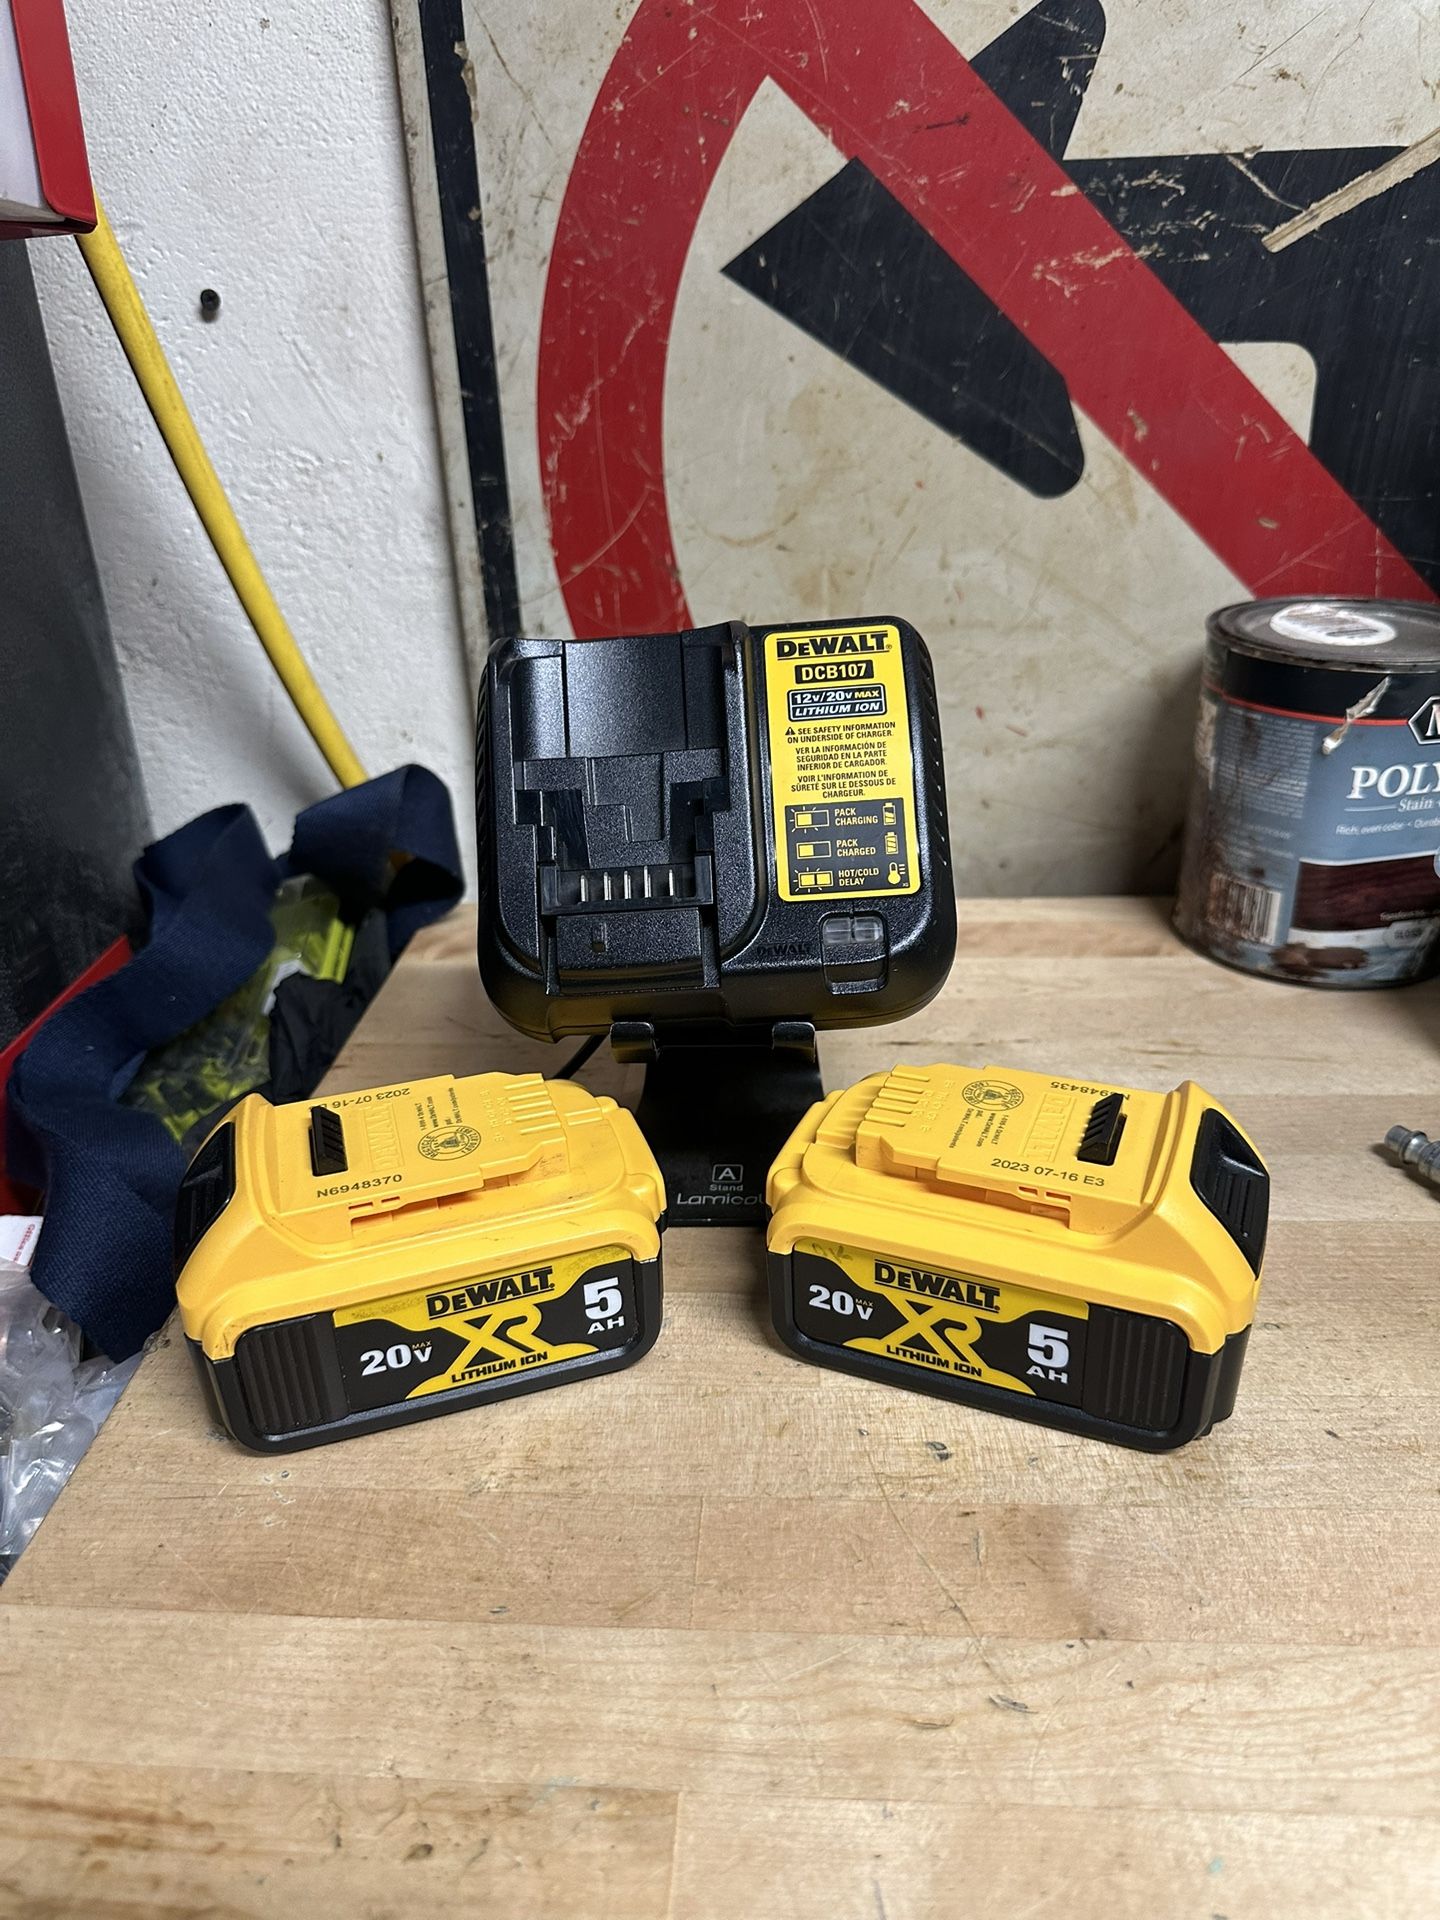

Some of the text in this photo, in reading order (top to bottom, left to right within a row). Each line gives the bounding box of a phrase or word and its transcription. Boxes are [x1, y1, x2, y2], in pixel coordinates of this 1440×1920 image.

[801, 663, 867, 681] DCB107
[854, 690, 880, 699] MAX
[794, 703, 880, 717] LITHIUM ION
[798, 722, 896, 735] SEE SAFETY INFORMATION
[787, 736, 799, 744] ON
[800, 733, 844, 743] UNDERSIDE
[845, 732, 855, 740] OF
[795, 747, 810, 755] VER
[876, 741, 887, 749] DE
[796, 750, 887, 763] SEGURIDAD EN LA PARTE
[797, 762, 831, 771] INFERIOR
[832, 761, 843, 769] DE
[797, 775, 816, 783] VOIR
[878, 770, 888, 778] DE
[821, 781, 837, 790] SUR
[838, 781, 848, 789] LE
[849, 779, 885, 788] DESSOUS
[885, 778, 896, 786] DE
[1398, 797, 1433, 812] Stain
[834, 808, 856, 816] PACK
[835, 816, 879, 826] CHARGING
[836, 839, 858, 847] PACK
[837, 847, 876, 856] CHARGED
[838, 867, 880, 878] HOT/COLD
[839, 877, 865, 886] DELAY
[375, 1087, 410, 1101] 2023
[1050, 1081, 1130, 1101] N948435
[332, 1096, 372, 1109] 07-16
[718, 1167, 736, 1180] A
[991, 1158, 1105, 1187] 2023 07-16 E3
[316, 1174, 403, 1198] N6948370
[709, 1183, 744, 1191] Stand
[583, 1277, 623, 1321] 5
[808, 1284, 874, 1321] 20V
[855, 1298, 874, 1308] MAX
[587, 1316, 625, 1335] AH
[432, 1305, 554, 1372] XR
[884, 1299, 990, 1367] XR
[413, 1340, 432, 1350] MAX
[1027, 1323, 1069, 1368] 5
[359, 1344, 433, 1376] 20V
[886, 1344, 982, 1377] LITHIUM ION
[451, 1351, 548, 1384] LITHIUM ION
[1026, 1365, 1069, 1384] AH
